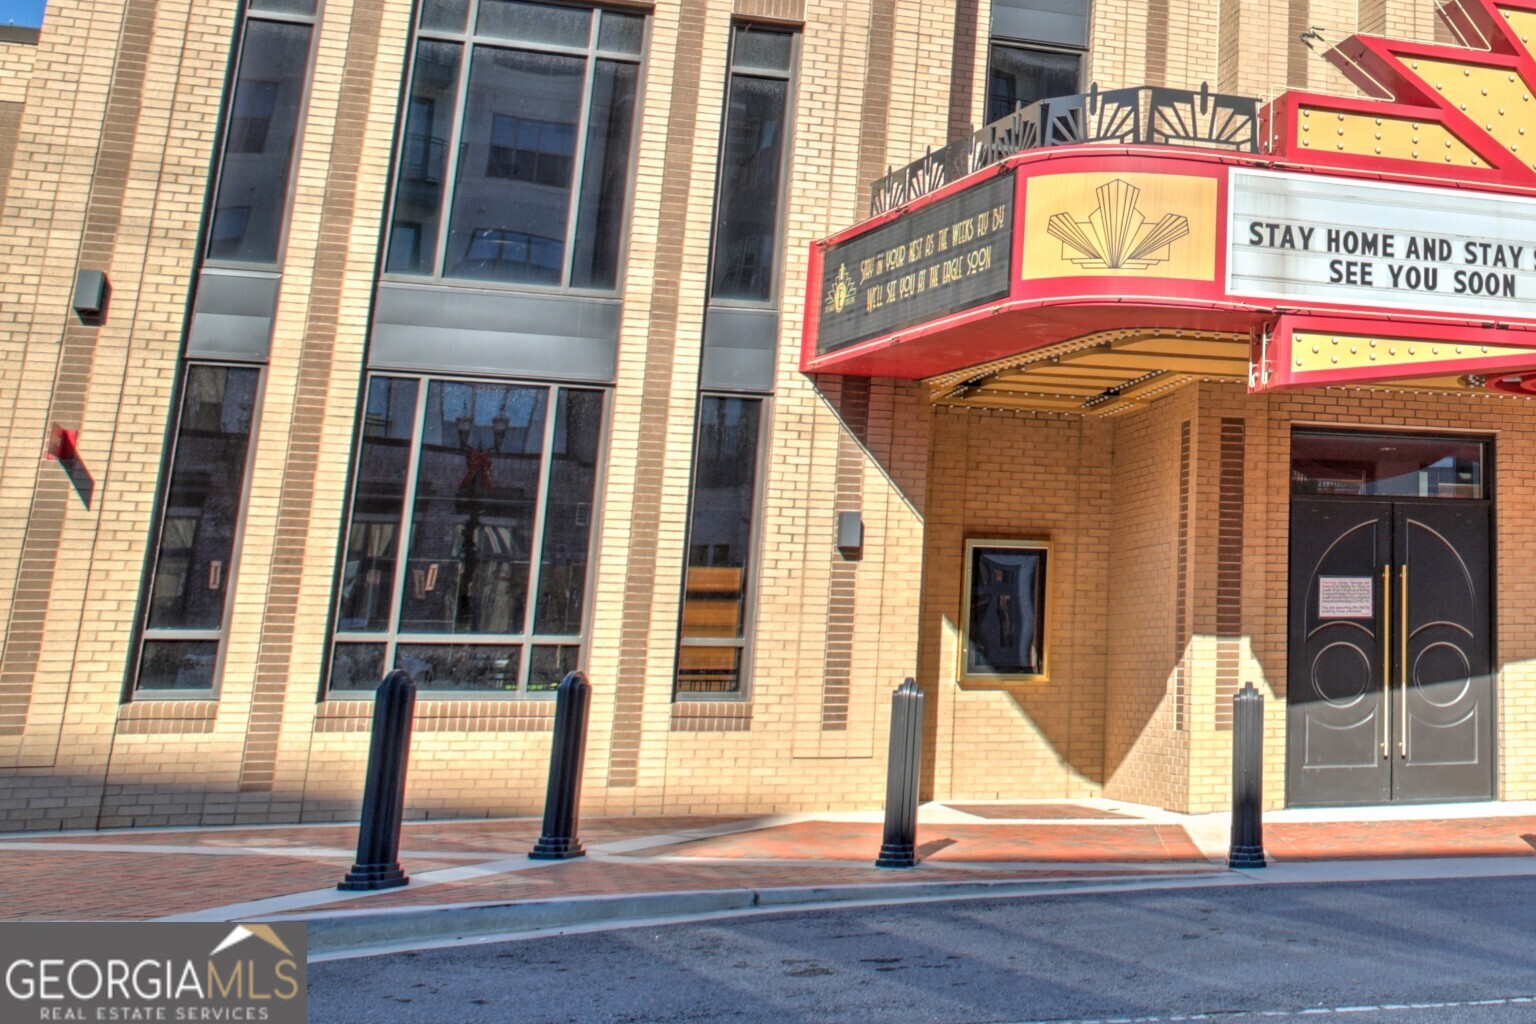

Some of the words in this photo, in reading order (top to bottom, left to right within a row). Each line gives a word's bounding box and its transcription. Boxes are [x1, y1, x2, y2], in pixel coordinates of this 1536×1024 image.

[859, 256, 875, 285] STAY
[885, 246, 906, 272] YOUR
[908, 238, 923, 263] NEST
[925, 233, 934, 256] AS
[938, 227, 948, 251] THE
[952, 218, 974, 246] WEEKS
[977, 211, 989, 237] FLY
[992, 205, 1005, 232] BY
[1249, 221, 1315, 251] STAY
[1326, 228, 1395, 258] HOME
[1405, 236, 1453, 262] AND
[1464, 242, 1523, 268] STAY
[886, 280, 897, 303] SEE
[900, 273, 916, 297] YOU
[917, 269, 927, 293] AT
[929, 264, 940, 289] THE
[942, 256, 964, 284] EAGLE
[966, 245, 992, 276] SOON
[1329, 259, 1373, 286] SEE
[1388, 264, 1438, 291] YOU
[1454, 270, 1516, 297] SOON
